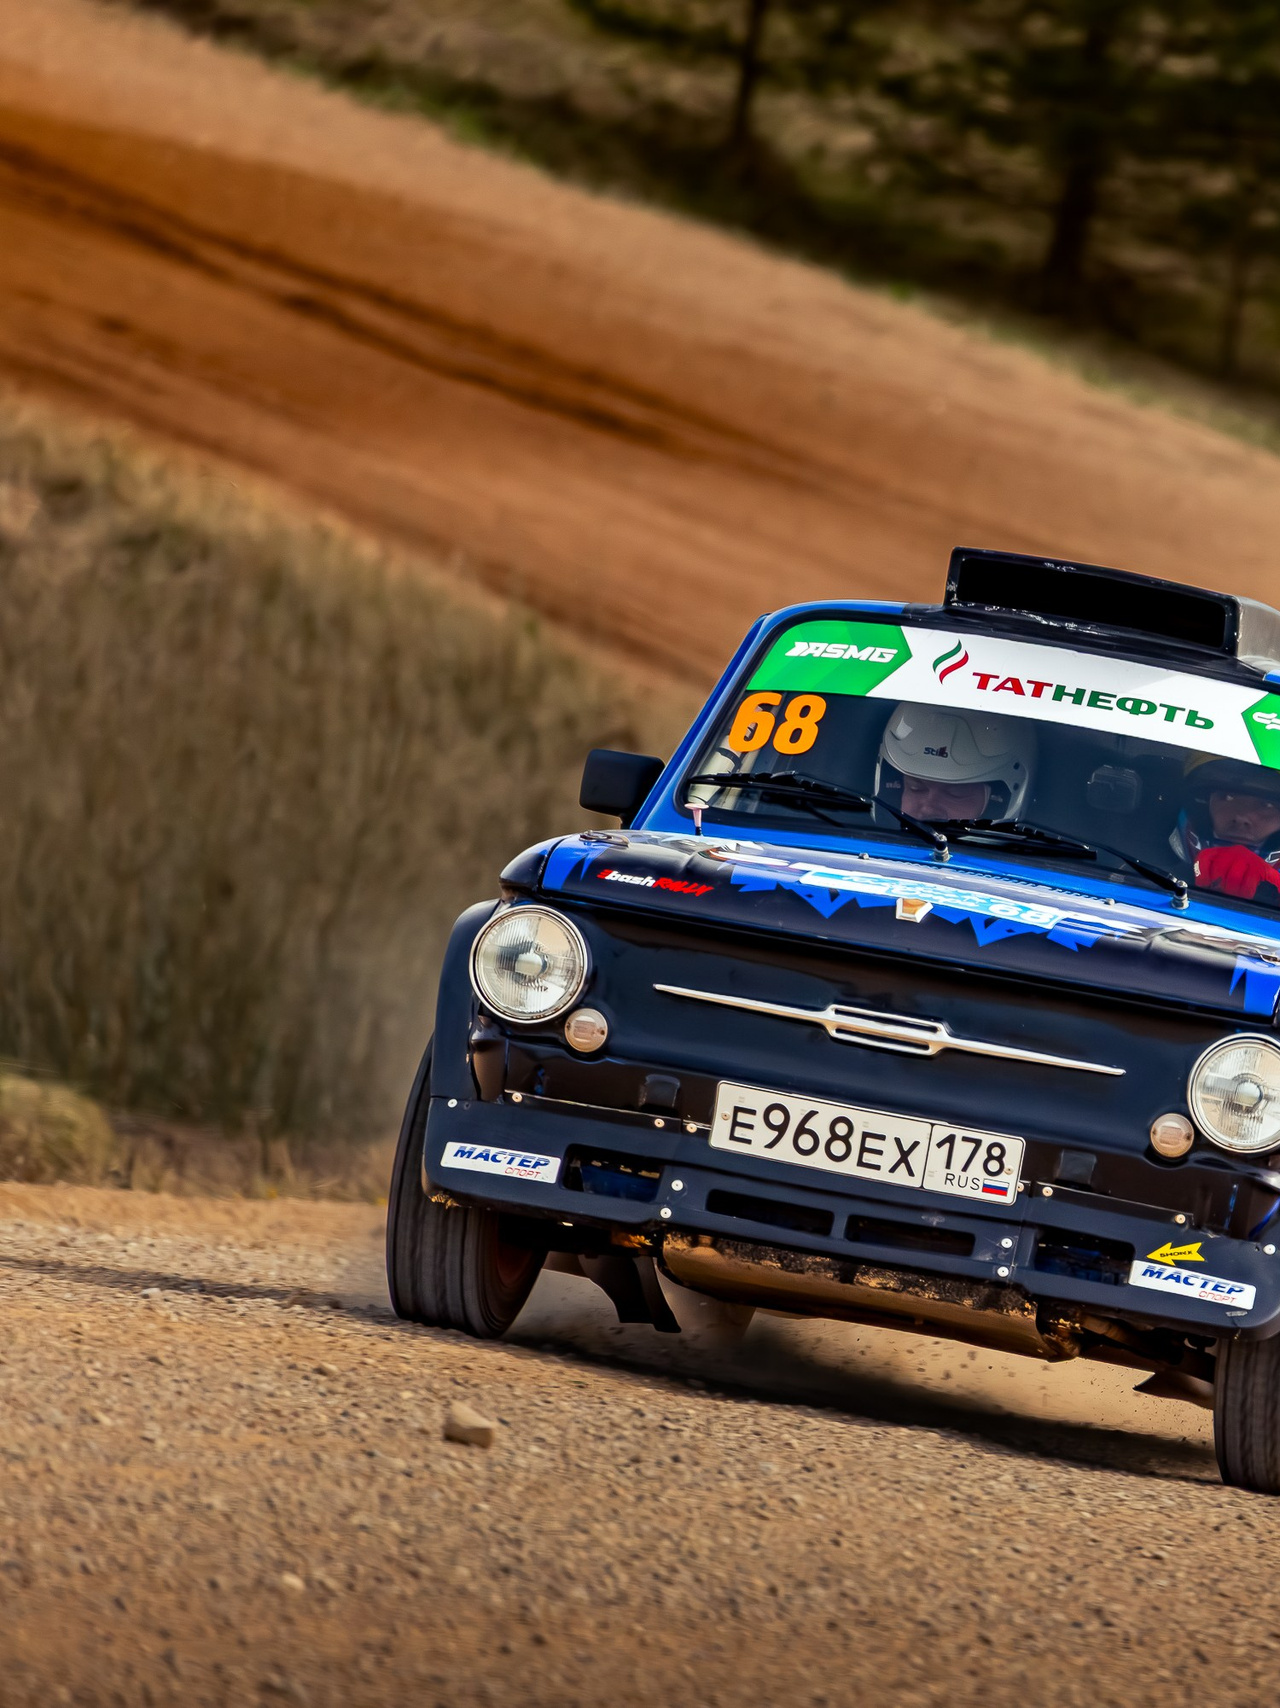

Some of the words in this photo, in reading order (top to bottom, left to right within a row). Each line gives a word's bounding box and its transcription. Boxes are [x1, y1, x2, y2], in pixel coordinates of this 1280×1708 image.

[972, 671, 1214, 730] ТАТНЕФТЬ
[728, 692, 827, 755] 68
[453, 1145, 551, 1169] МАСТЕР
[936, 1134, 1007, 1177] 178
[945, 1172, 980, 1191] RUS
[1141, 1264, 1246, 1295] МАСТЕР
